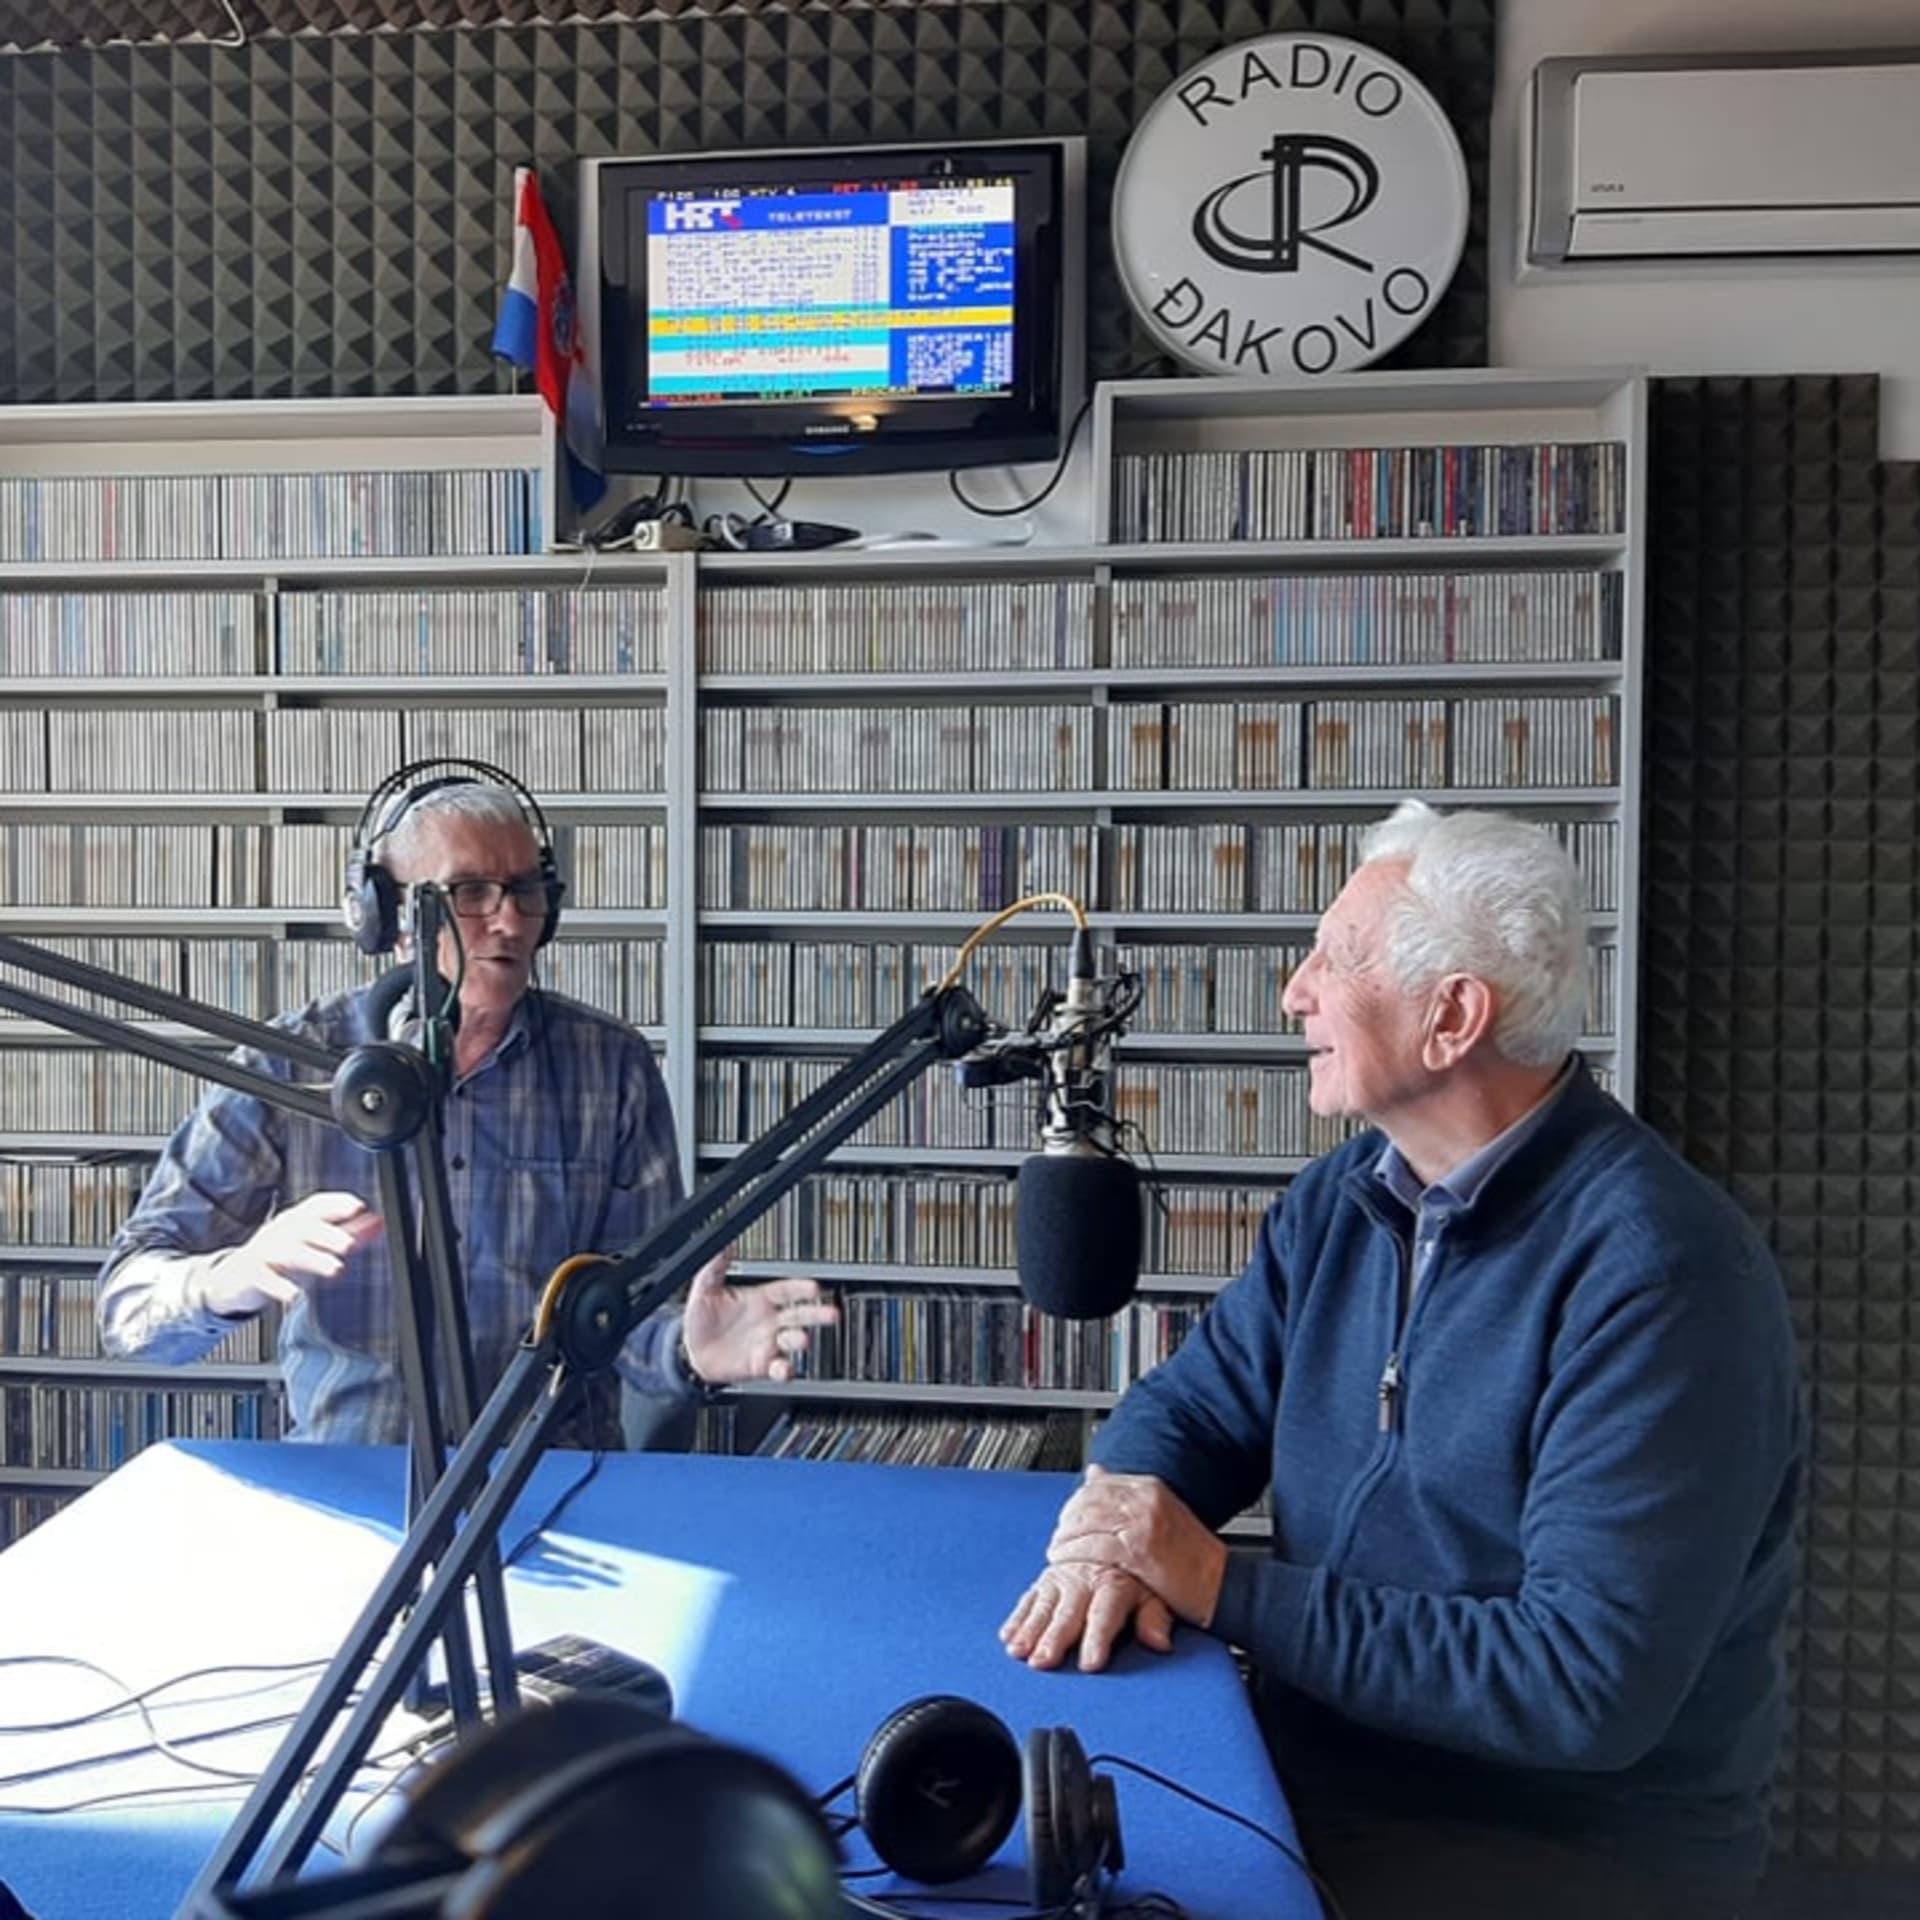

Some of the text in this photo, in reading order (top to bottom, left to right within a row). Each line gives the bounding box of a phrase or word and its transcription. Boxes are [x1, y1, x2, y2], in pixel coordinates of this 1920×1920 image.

[1177, 43, 1403, 126] RADIO
[768, 209, 852, 223] TELETEKST
[1153, 266, 1430, 375] ĐAKOVO
